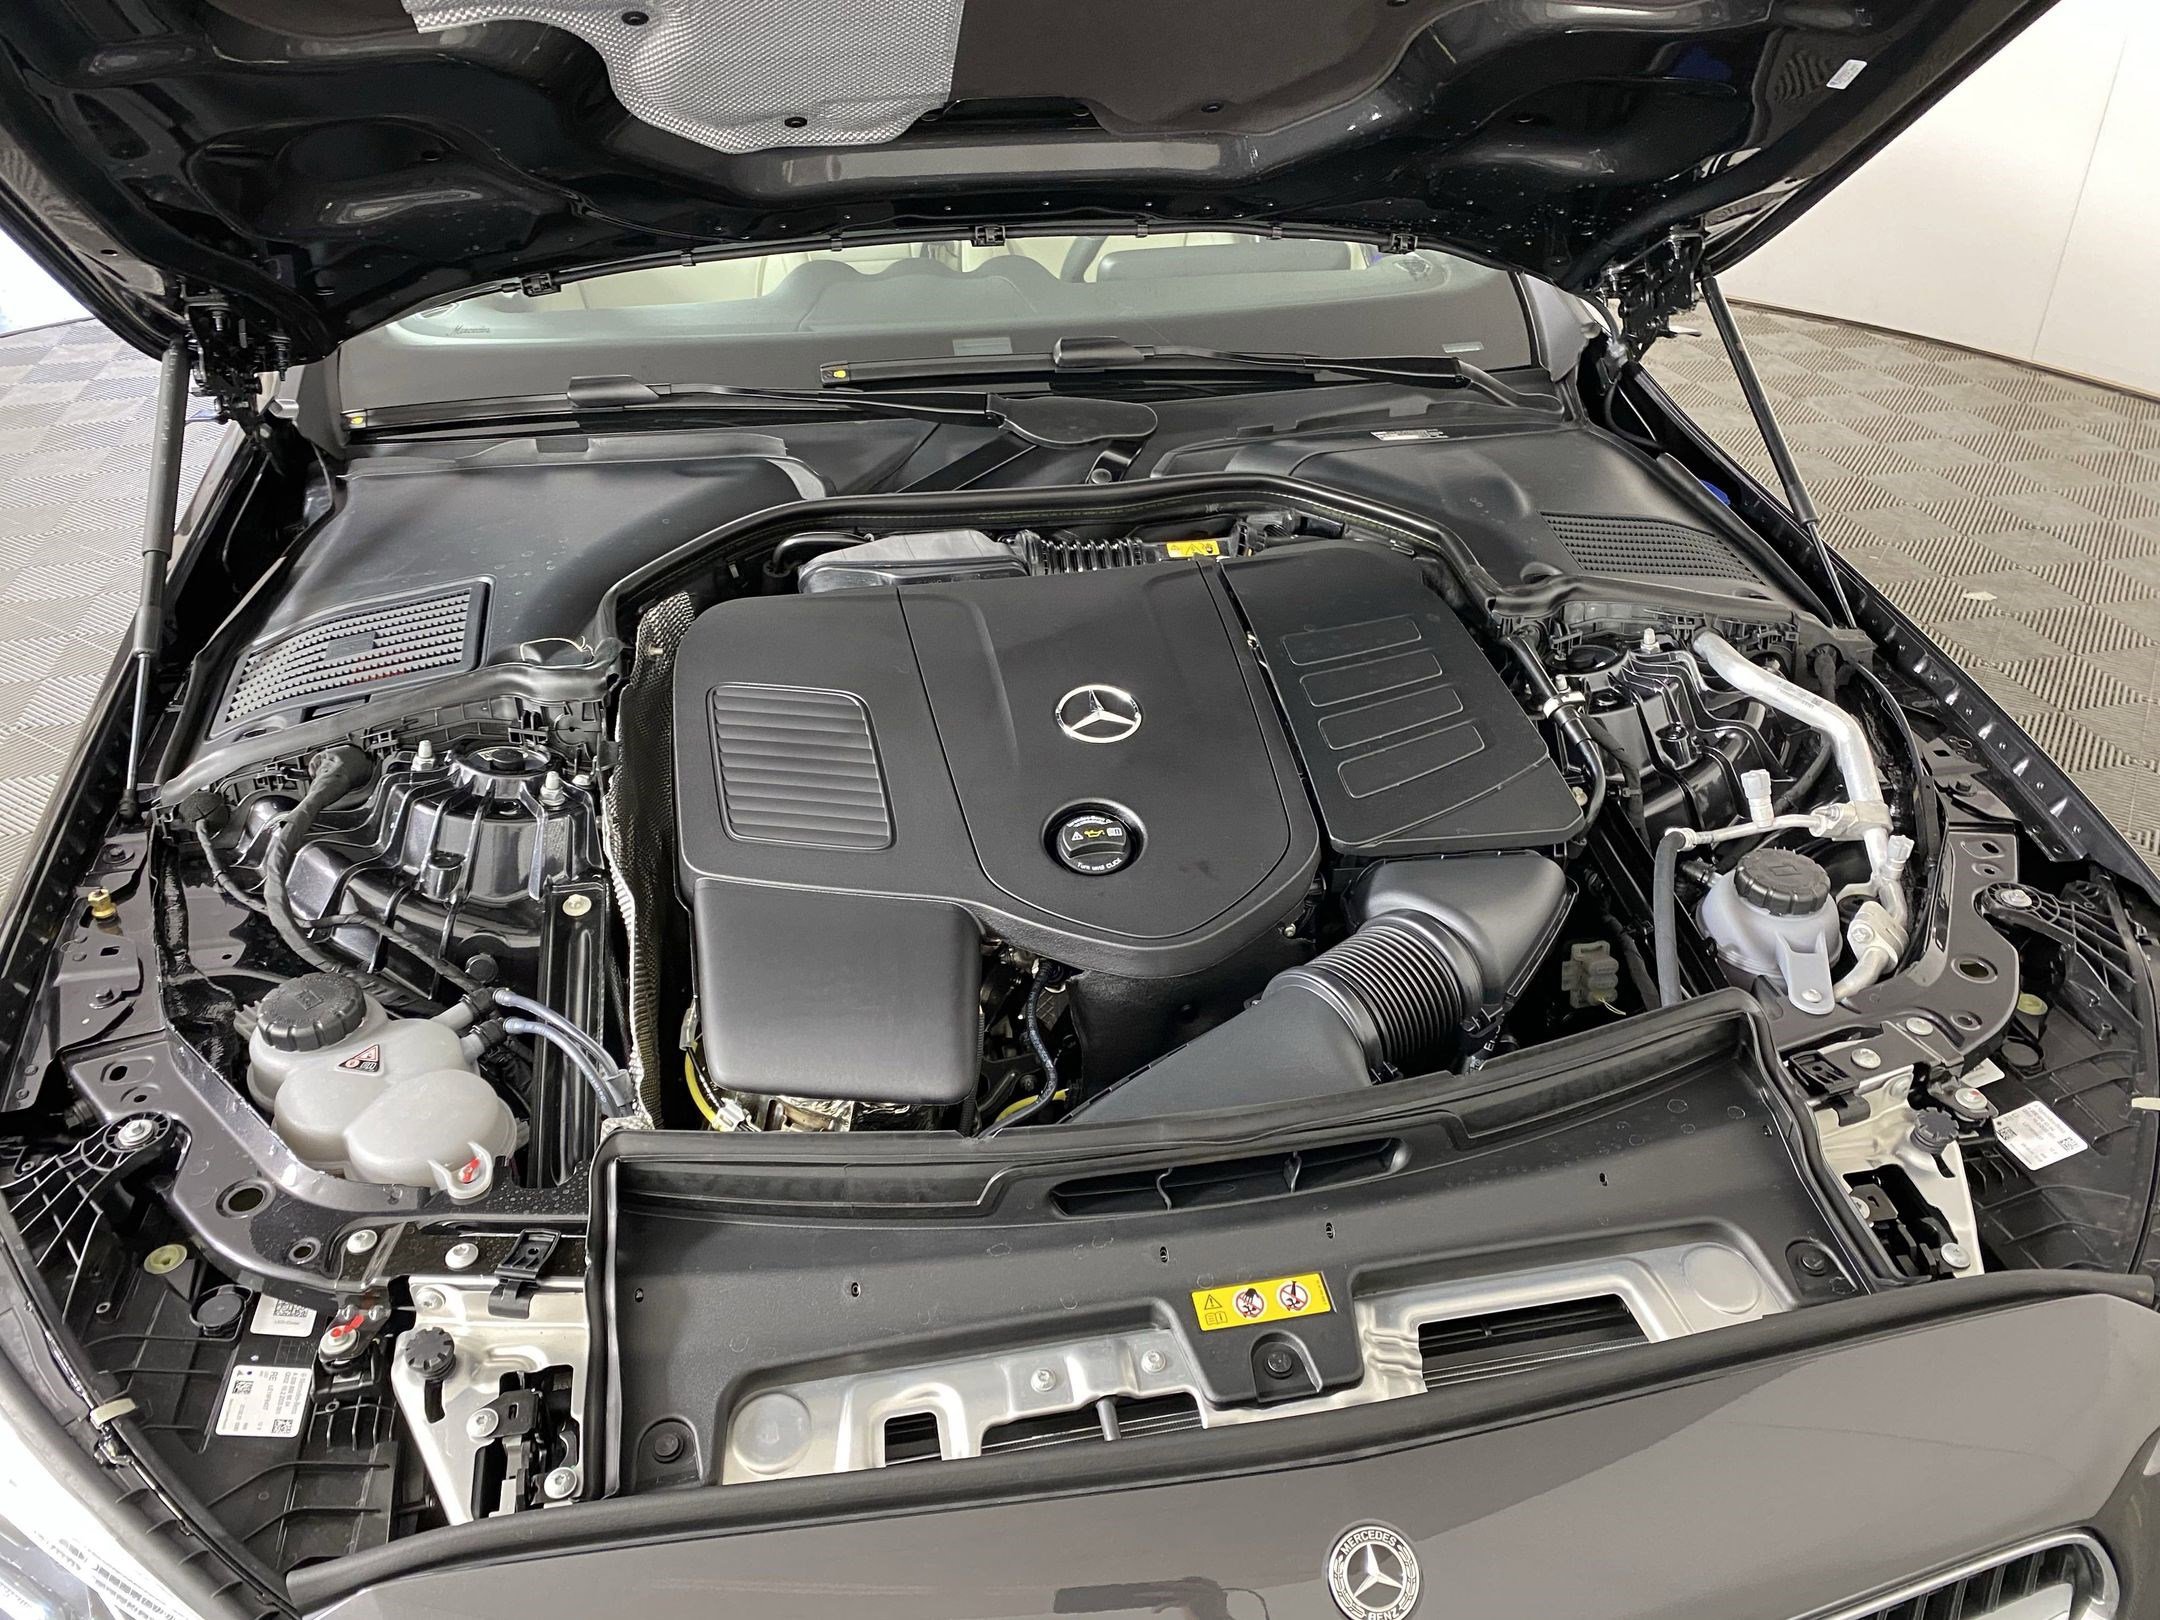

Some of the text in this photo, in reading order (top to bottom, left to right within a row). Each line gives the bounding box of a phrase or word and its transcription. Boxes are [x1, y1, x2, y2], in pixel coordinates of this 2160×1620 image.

[1077, 862, 1090, 870] Turn
[1106, 857, 1122, 869] CLICK
[1340, 1530, 1397, 1556] MERCEDES
[1368, 1607, 1399, 1620] BENZ
